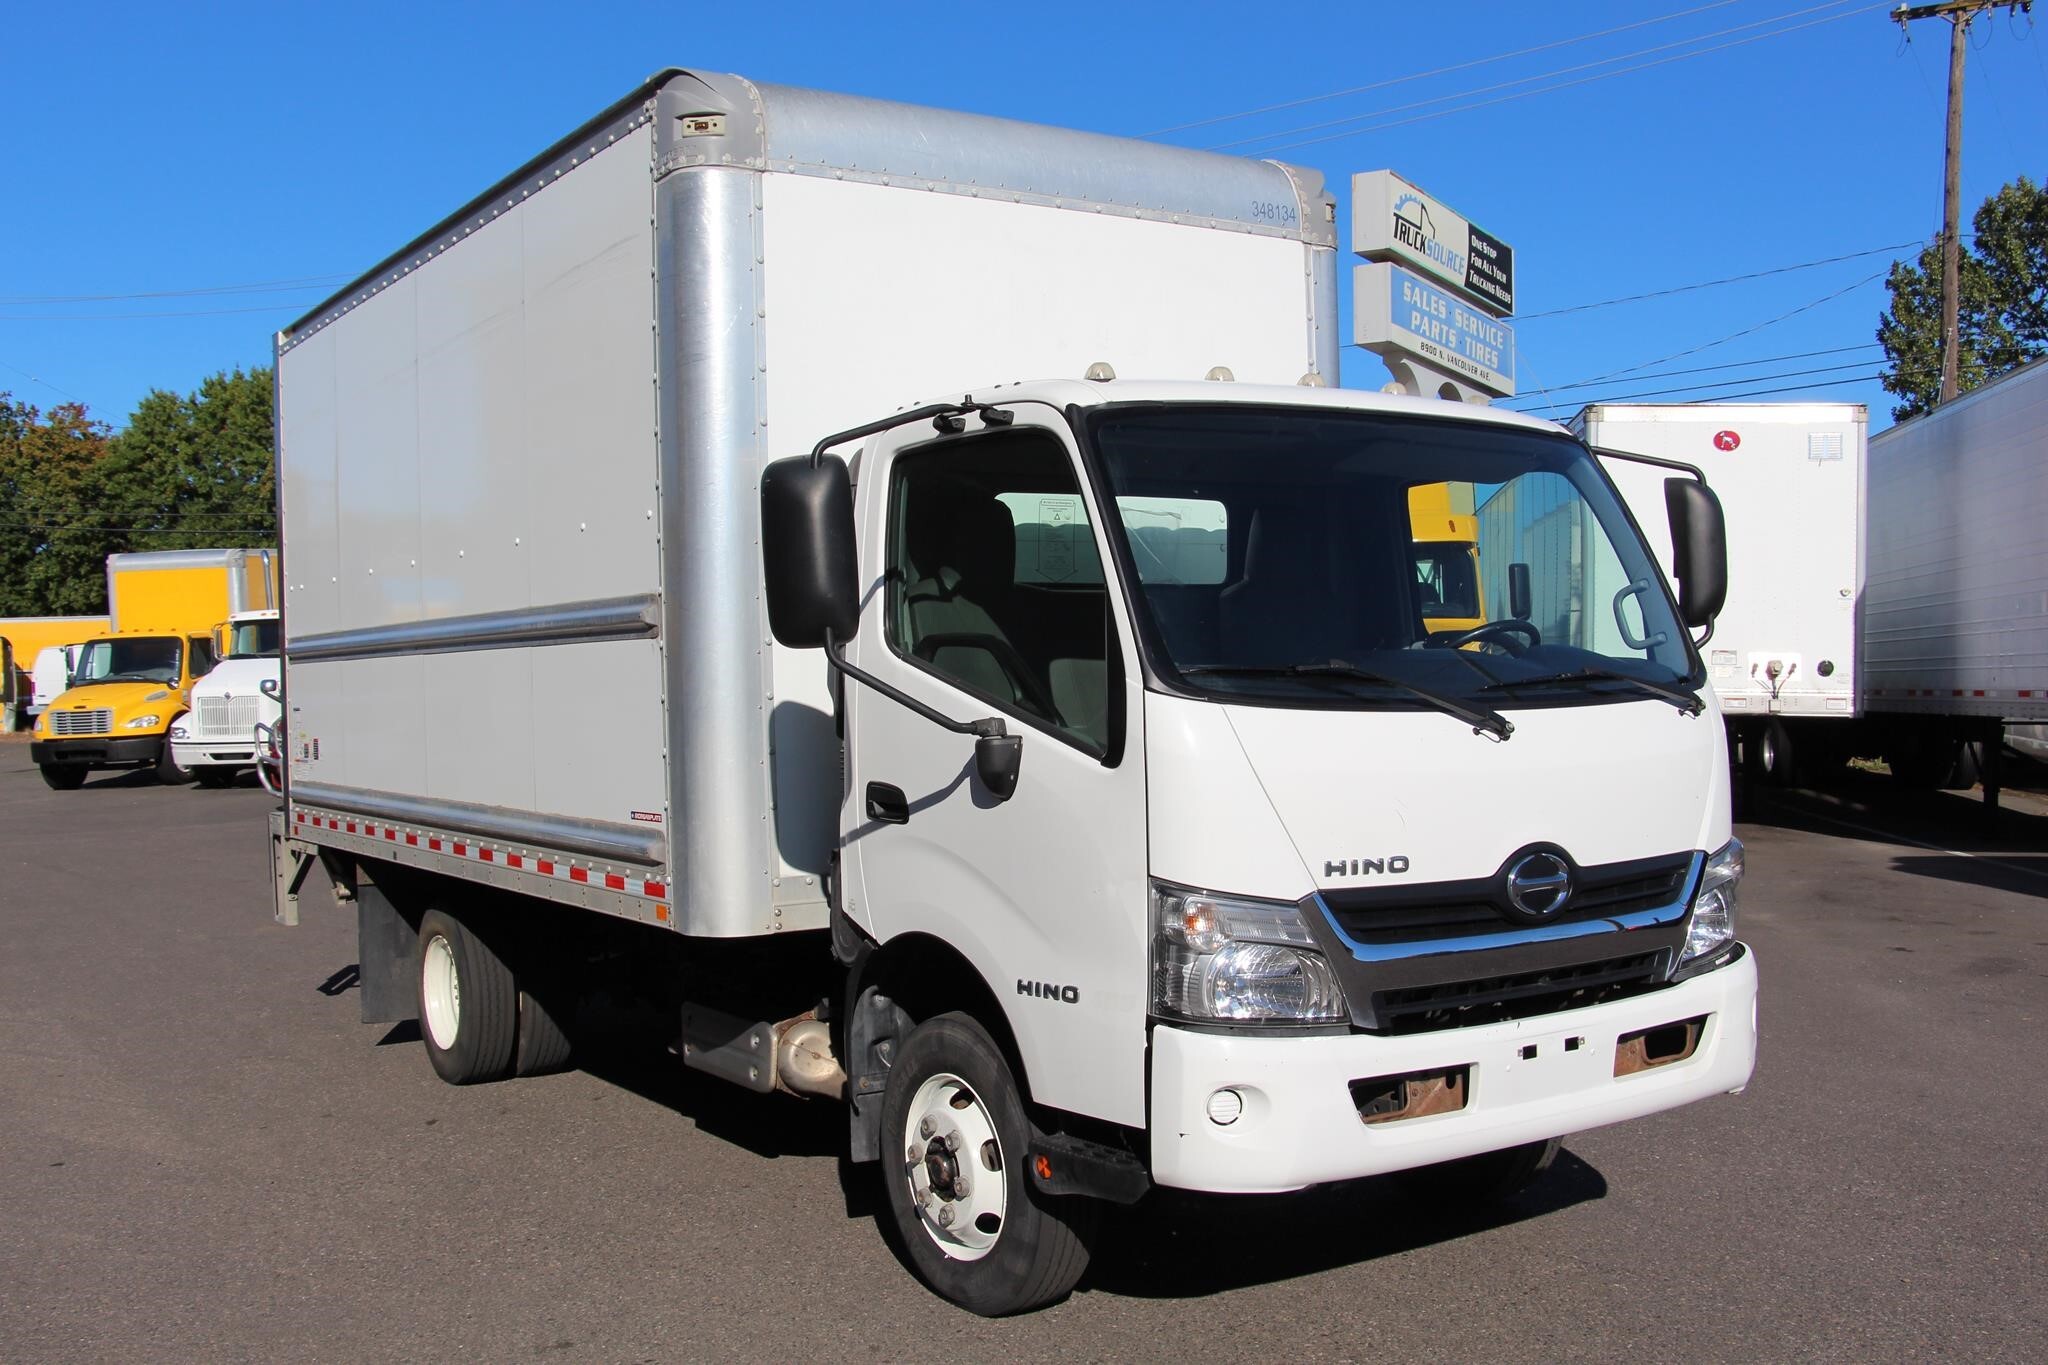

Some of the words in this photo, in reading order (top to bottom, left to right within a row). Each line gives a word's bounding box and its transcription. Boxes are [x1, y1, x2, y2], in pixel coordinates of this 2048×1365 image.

[1251, 200, 1296, 222] 348134
[1403, 281, 1446, 319] SALES
[1455, 308, 1503, 349] SERVICE
[1411, 310, 1456, 348] PARTS
[1465, 336, 1498, 369] TIRES
[1420, 341, 1437, 357] 8900
[1447, 353, 1478, 376] VANCOUVER
[1324, 856, 1409, 877] HINO
[1017, 979, 1080, 1004] HINO
